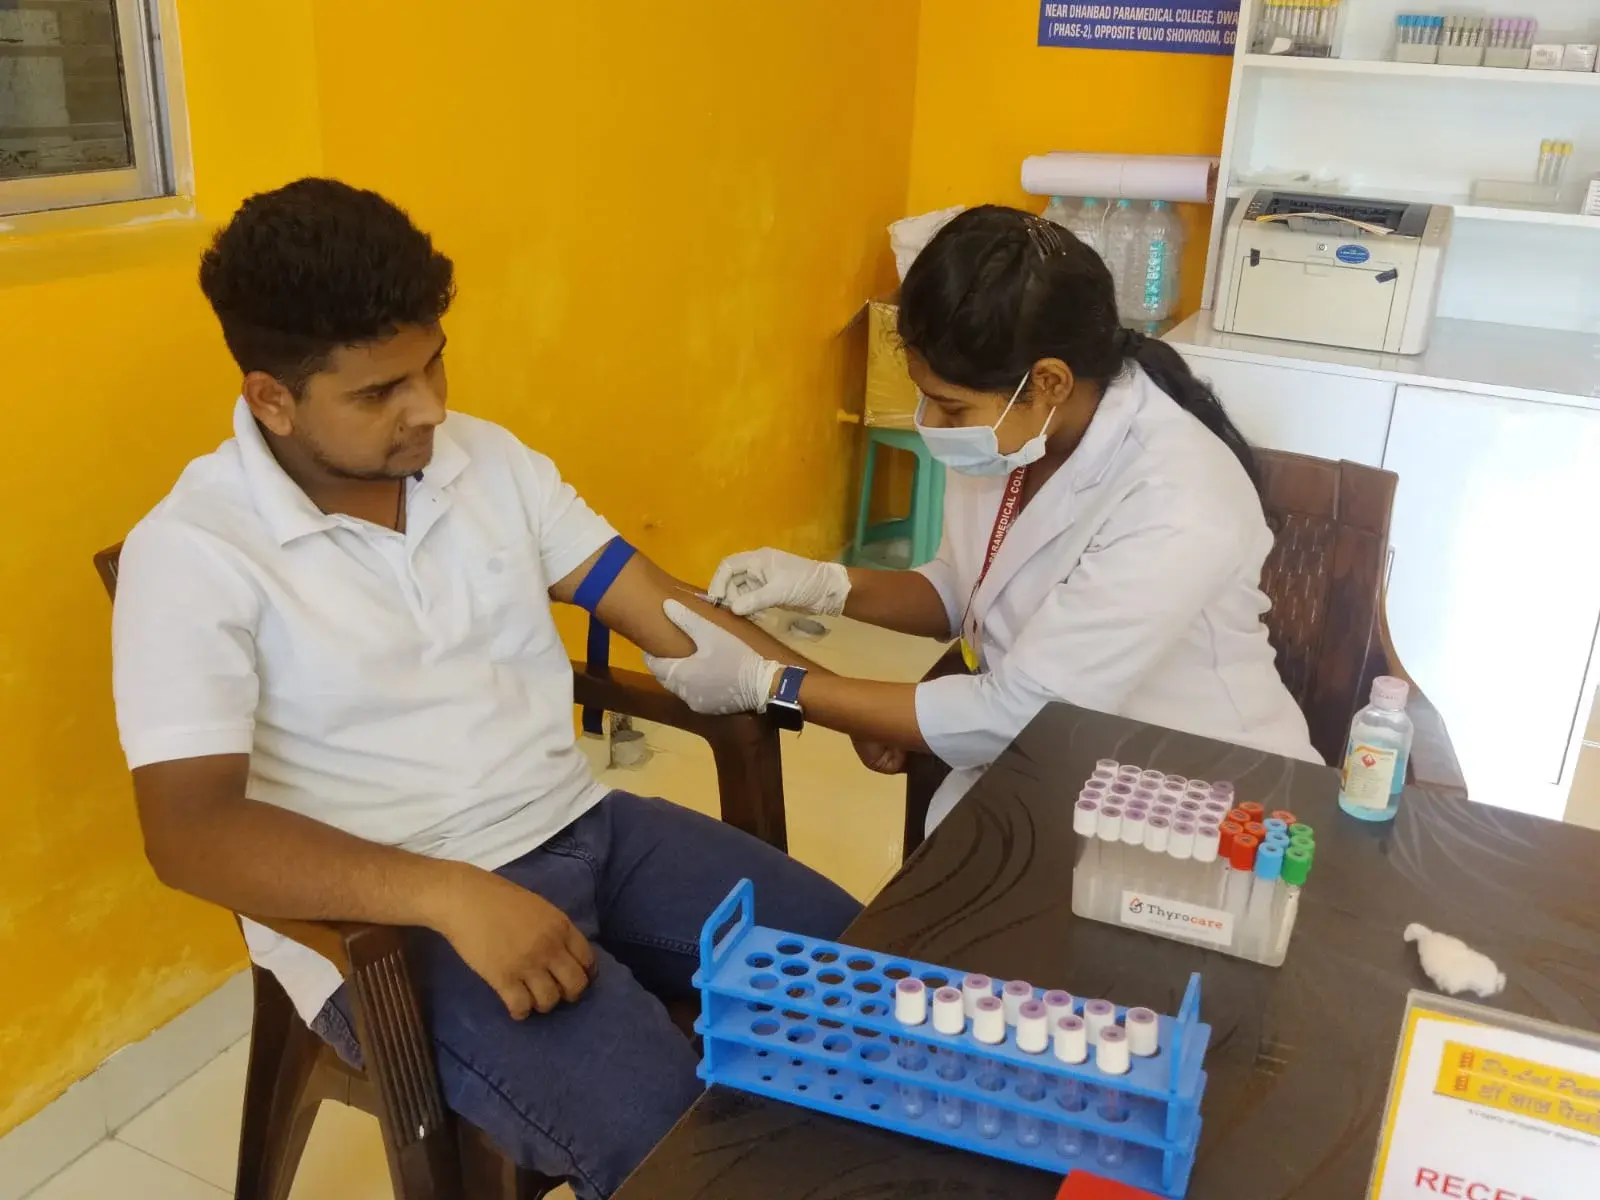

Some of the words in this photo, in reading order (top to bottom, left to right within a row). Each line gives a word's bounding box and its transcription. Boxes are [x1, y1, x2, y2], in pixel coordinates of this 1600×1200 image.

[1045, 4, 1068, 17] NEAR
[1069, 5, 1111, 19] DHANBAD
[1112, 7, 1174, 22] PARAMEDICAL
[1175, 9, 1215, 25] COLLEGE,
[1216, 10, 1240, 25] DWA
[1094, 25, 1135, 39] OPPOSITE
[1136, 27, 1164, 41] VOLVO
[1165, 28, 1221, 45] SHOWROOM,
[989, 496, 1016, 562] PARAMEDICAL
[1146, 903, 1224, 930] Thyrocare
